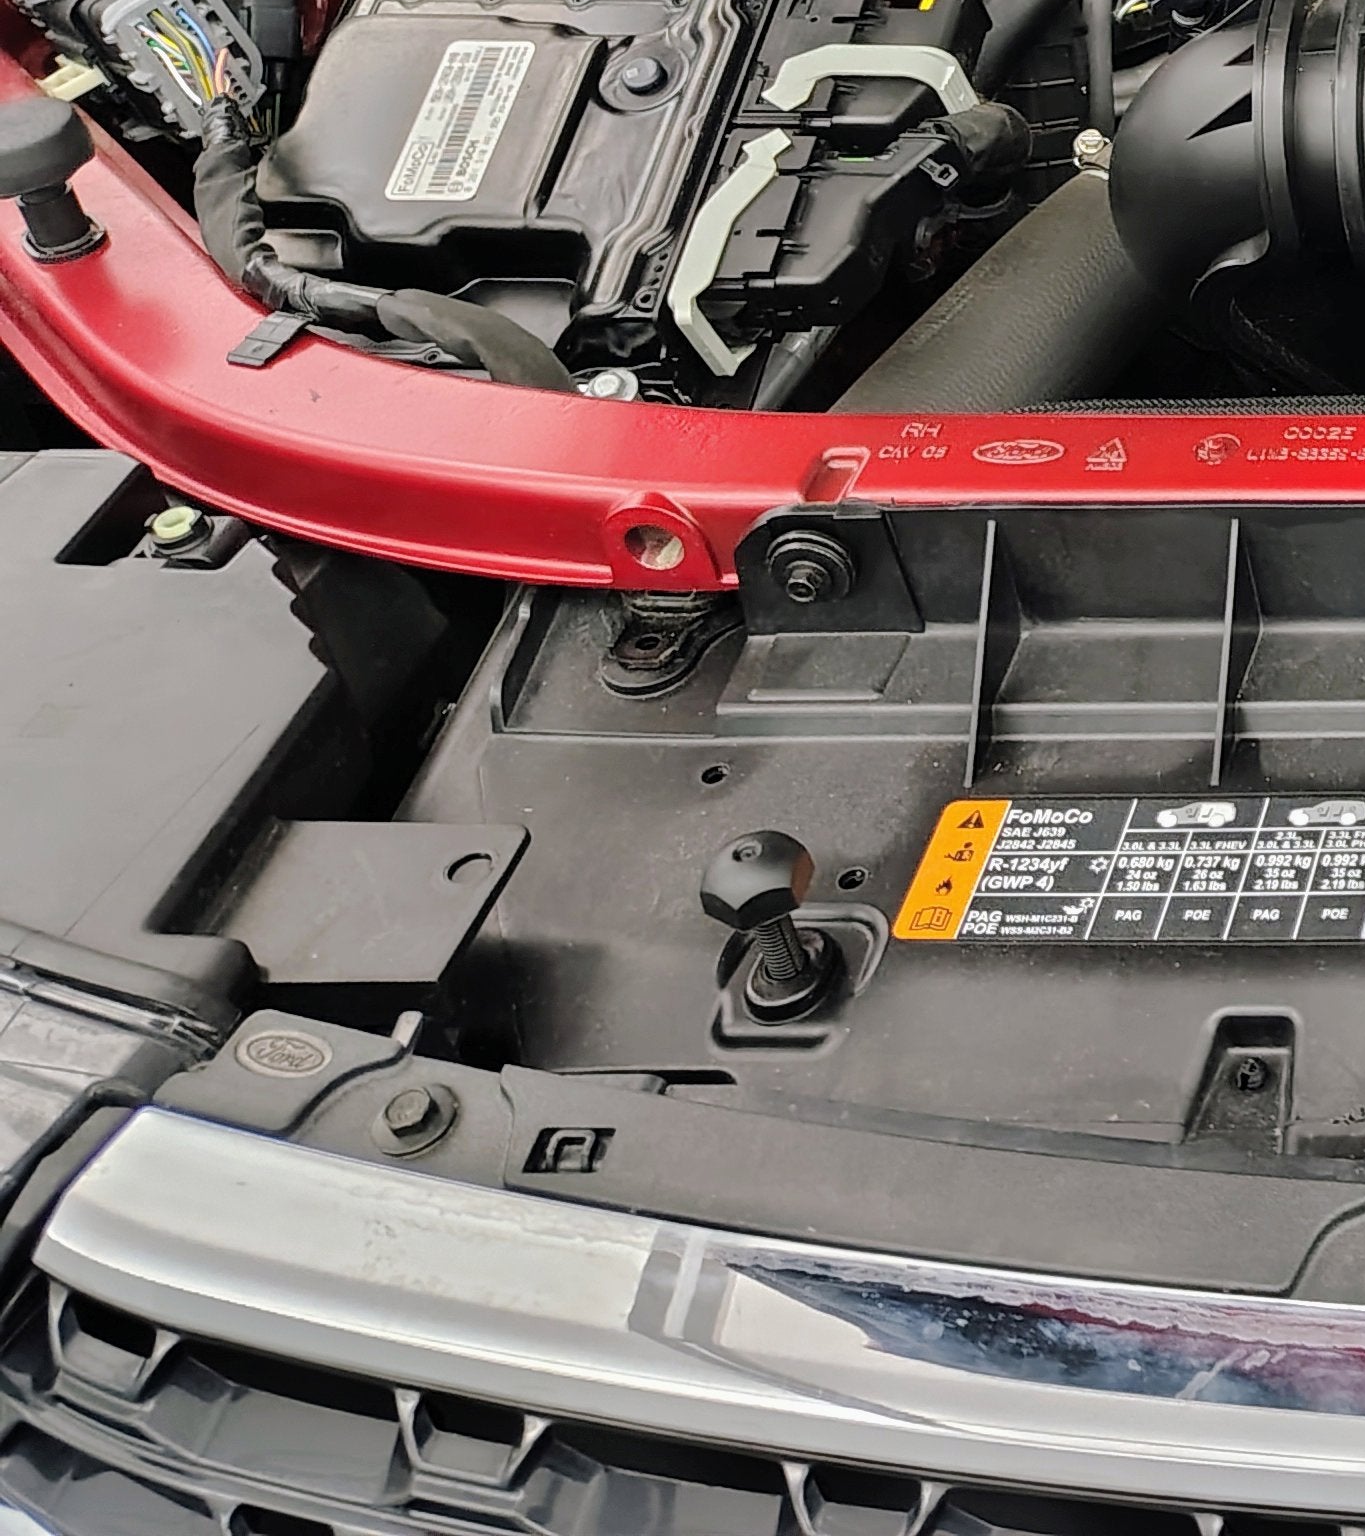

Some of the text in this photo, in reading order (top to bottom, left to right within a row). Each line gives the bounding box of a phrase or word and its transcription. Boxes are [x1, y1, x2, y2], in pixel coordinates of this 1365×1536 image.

[1006, 809, 1093, 824] FoMoCo
[1001, 827, 1067, 837] SAE J639
[995, 839, 1077, 849] J2842 J2845
[1122, 841, 1181, 851] 3.0L & 3.3L
[1190, 840, 1247, 850] 3.3L FHEV
[1282, 841, 1291, 849] &
[1293, 841, 1316, 849] 3.3L
[988, 857, 1070, 874] R-1234yf
[1118, 856, 1174, 871] 0.680 kg
[1184, 856, 1241, 871] 0.737 kg
[1256, 854, 1312, 869] 0.992 kg
[1321, 854, 1359, 867] 0.992
[1125, 870, 1158, 880] 24 oz
[1192, 869, 1225, 880] 26 oz
[1263, 868, 1296, 878] 35 oz
[1329, 868, 1362, 878] 35 oz
[980, 876, 1054, 891] (GWP 4)
[1117, 881, 1160, 891] 1.50 lbs
[1183, 880, 1227, 891] 1.63 lbs
[1253, 879, 1299, 890] 2.19 lbs
[1319, 879, 1365, 890] 2.19 lbs
[966, 911, 1002, 923] PAG
[1115, 910, 1142, 921] PAG
[1184, 909, 1211, 921] POE
[1252, 909, 1280, 921] PAG
[1321, 908, 1349, 920] POE
[962, 923, 998, 934] POE
[255, 1036, 315, 1068] Ford
